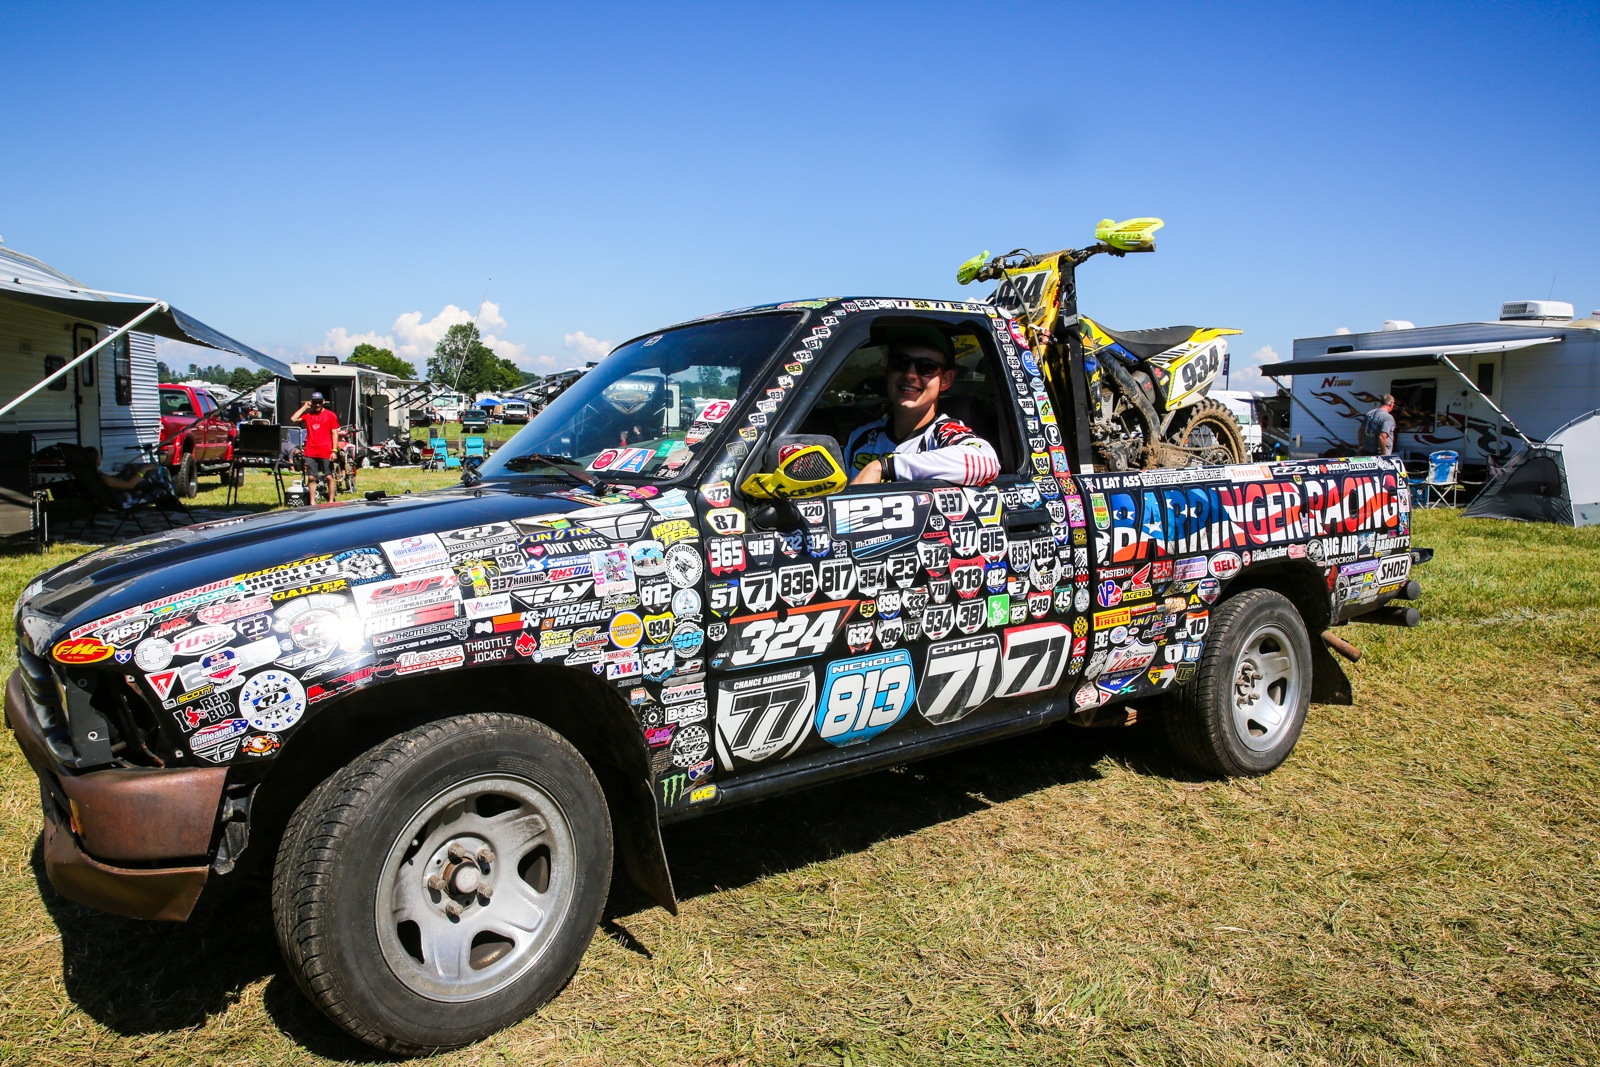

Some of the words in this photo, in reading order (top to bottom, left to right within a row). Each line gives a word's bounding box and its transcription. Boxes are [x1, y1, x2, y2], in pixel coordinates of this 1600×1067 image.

[997, 273, 1047, 310] 934
[914, 300, 930, 308] 934
[824, 316, 838, 324] 23
[815, 327, 829, 336] 15
[796, 352, 812, 361] 423
[1182, 345, 1219, 392] 934
[751, 414, 765, 424] 35
[747, 430, 761, 440] 35
[1032, 440, 1045, 450] 120
[721, 465, 734, 476] 14
[1035, 456, 1049, 468] 934
[1350, 461, 1378, 471] DUNLOP
[1103, 476, 1121, 489] EAT
[1122, 474, 1141, 488] ASS
[708, 488, 730, 501] 373
[938, 493, 963, 512] 337
[1003, 492, 1020, 505] 132
[803, 506, 823, 517] 120
[973, 493, 998, 516] 27
[1051, 507, 1065, 519] 469
[713, 514, 738, 530] 87
[833, 495, 915, 534] 123
[1111, 482, 1304, 565] BARRINGER
[1304, 473, 1399, 538] RACING
[652, 520, 690, 540] MOTO
[662, 528, 699, 547] TEES
[952, 526, 978, 549] 377
[1054, 528, 1067, 536] 21
[543, 542, 572, 556] DIRT
[572, 537, 608, 551] BIKES
[748, 540, 775, 556] 913
[980, 533, 1005, 554] 815
[1034, 541, 1054, 559] 365
[1322, 536, 1340, 564] BIG
[1341, 535, 1358, 559] AIR
[499, 555, 523, 569] 352
[711, 541, 742, 568] 365
[922, 548, 949, 569] 314
[1012, 547, 1030, 564] 893
[1252, 545, 1288, 562] BikeMaster
[547, 566, 591, 581] AMSOIL
[893, 558, 918, 581] 23
[1213, 558, 1238, 575] BELL
[1380, 558, 1409, 581] SHOEI
[370, 575, 445, 599] CMP
[492, 577, 513, 591] 337
[513, 573, 544, 585] HAULING
[781, 570, 813, 597] 836
[822, 564, 853, 593] 817
[860, 567, 884, 590] 354
[953, 569, 981, 590] 313
[175, 584, 241, 610] MOTOREX
[272, 579, 347, 601] GALFER
[320, 585, 348, 594] USA
[642, 583, 672, 606] 812
[710, 586, 738, 609] 51
[745, 578, 775, 605] 71
[1124, 590, 1152, 600] ACERBIS
[862, 603, 877, 614] 93
[880, 593, 901, 612] 899
[1030, 598, 1049, 613] 249
[1055, 591, 1071, 608] 45
[545, 602, 601, 619] MOOSE
[553, 609, 613, 627] RACING
[960, 604, 984, 627] 381
[1095, 611, 1130, 628] PIRELLI
[241, 617, 268, 637] 23
[648, 620, 671, 637] 934
[925, 609, 952, 633] 934
[1189, 618, 1206, 636] 10
[105, 619, 146, 644] 469
[171, 625, 233, 652] TUSK
[709, 624, 726, 637] 934
[731, 609, 842, 666] 324
[880, 627, 902, 644] 196
[54, 642, 108, 656] FMF
[464, 636, 512, 653] THROTTLE
[473, 648, 508, 664] JOCKEY
[643, 649, 675, 676] 354
[832, 653, 905, 674] NICHOLE
[931, 648, 997, 668] CHUCK
[1003, 634, 1067, 695] 71
[1107, 655, 1152, 672] LUCAS
[211, 660, 231, 672] REDBUD
[610, 661, 640, 676] AMA
[733, 676, 763, 691] CHANCE
[763, 671, 801, 685] BARRINGER
[924, 648, 999, 718] 71
[178, 685, 214, 703] SCOTT
[202, 691, 230, 710] RED
[820, 664, 912, 738] 813
[206, 705, 236, 723] BUD
[667, 702, 705, 723] BOB'S
[730, 681, 810, 752] 77
[690, 787, 716, 803] WC
